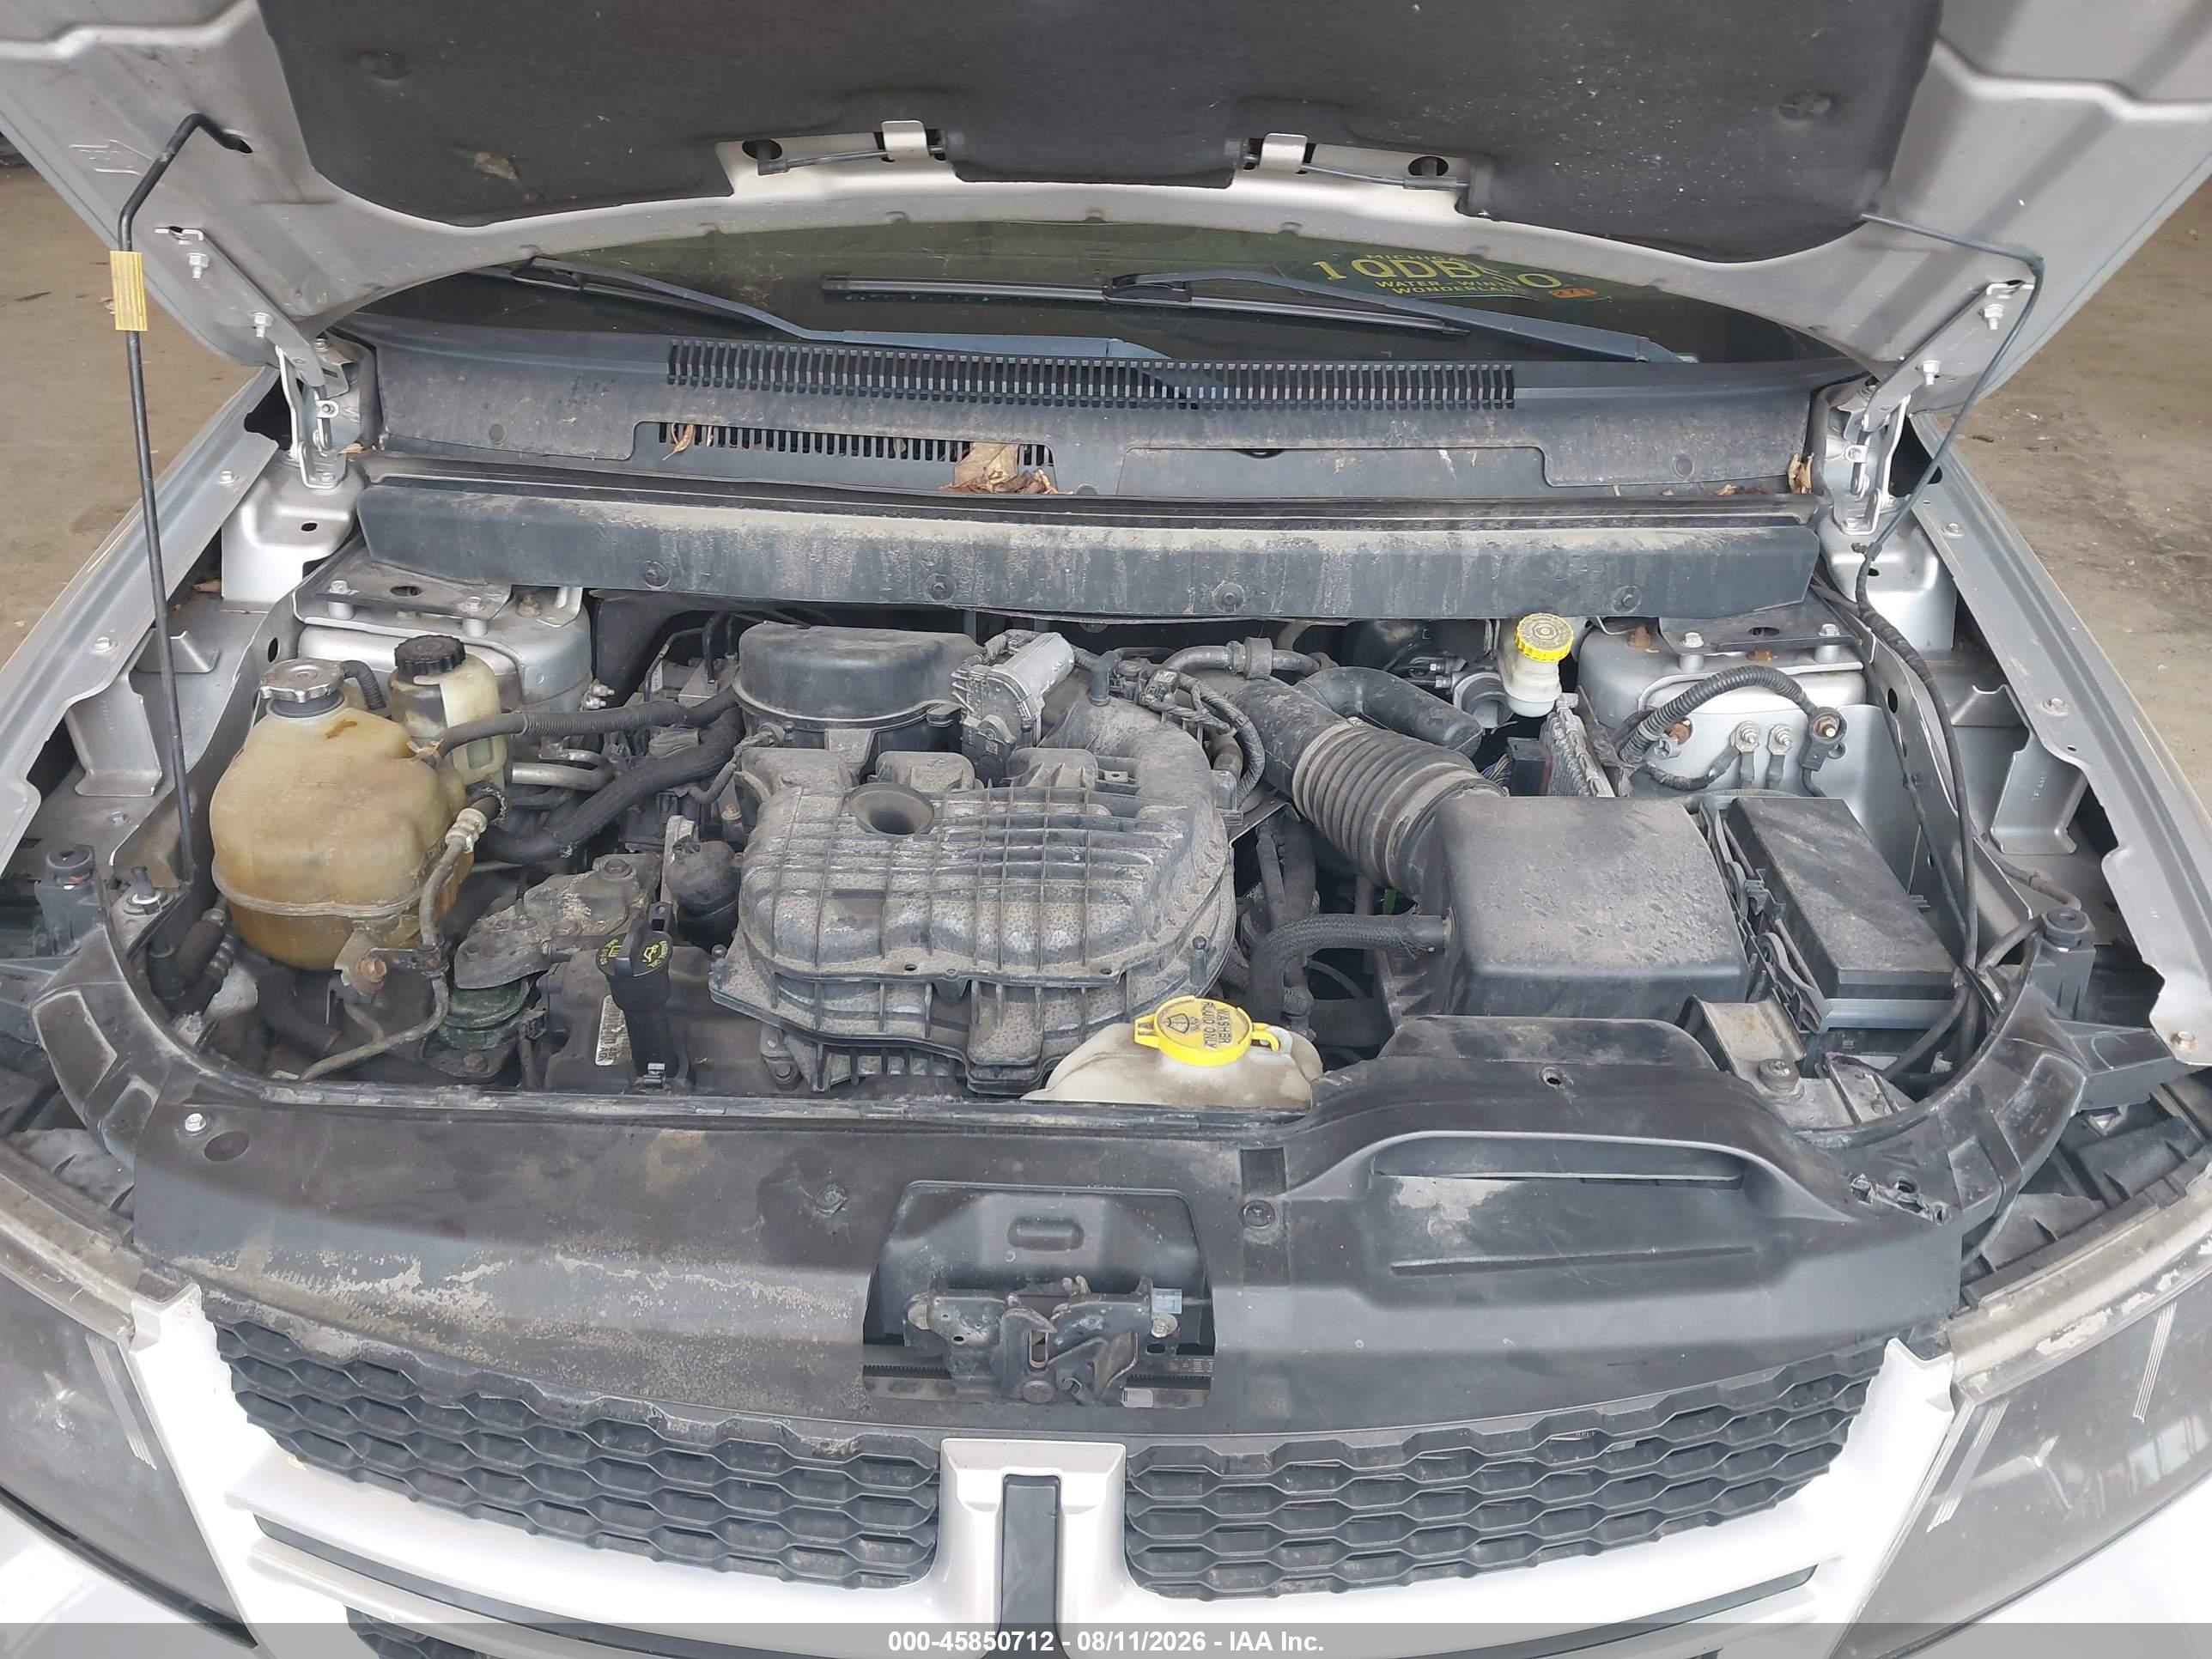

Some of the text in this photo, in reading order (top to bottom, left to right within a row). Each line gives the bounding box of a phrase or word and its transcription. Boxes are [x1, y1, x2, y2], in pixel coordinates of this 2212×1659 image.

[1202, 1000, 1218, 1048] FLUID ONLY
[1216, 1008, 1231, 1044] WASHER
